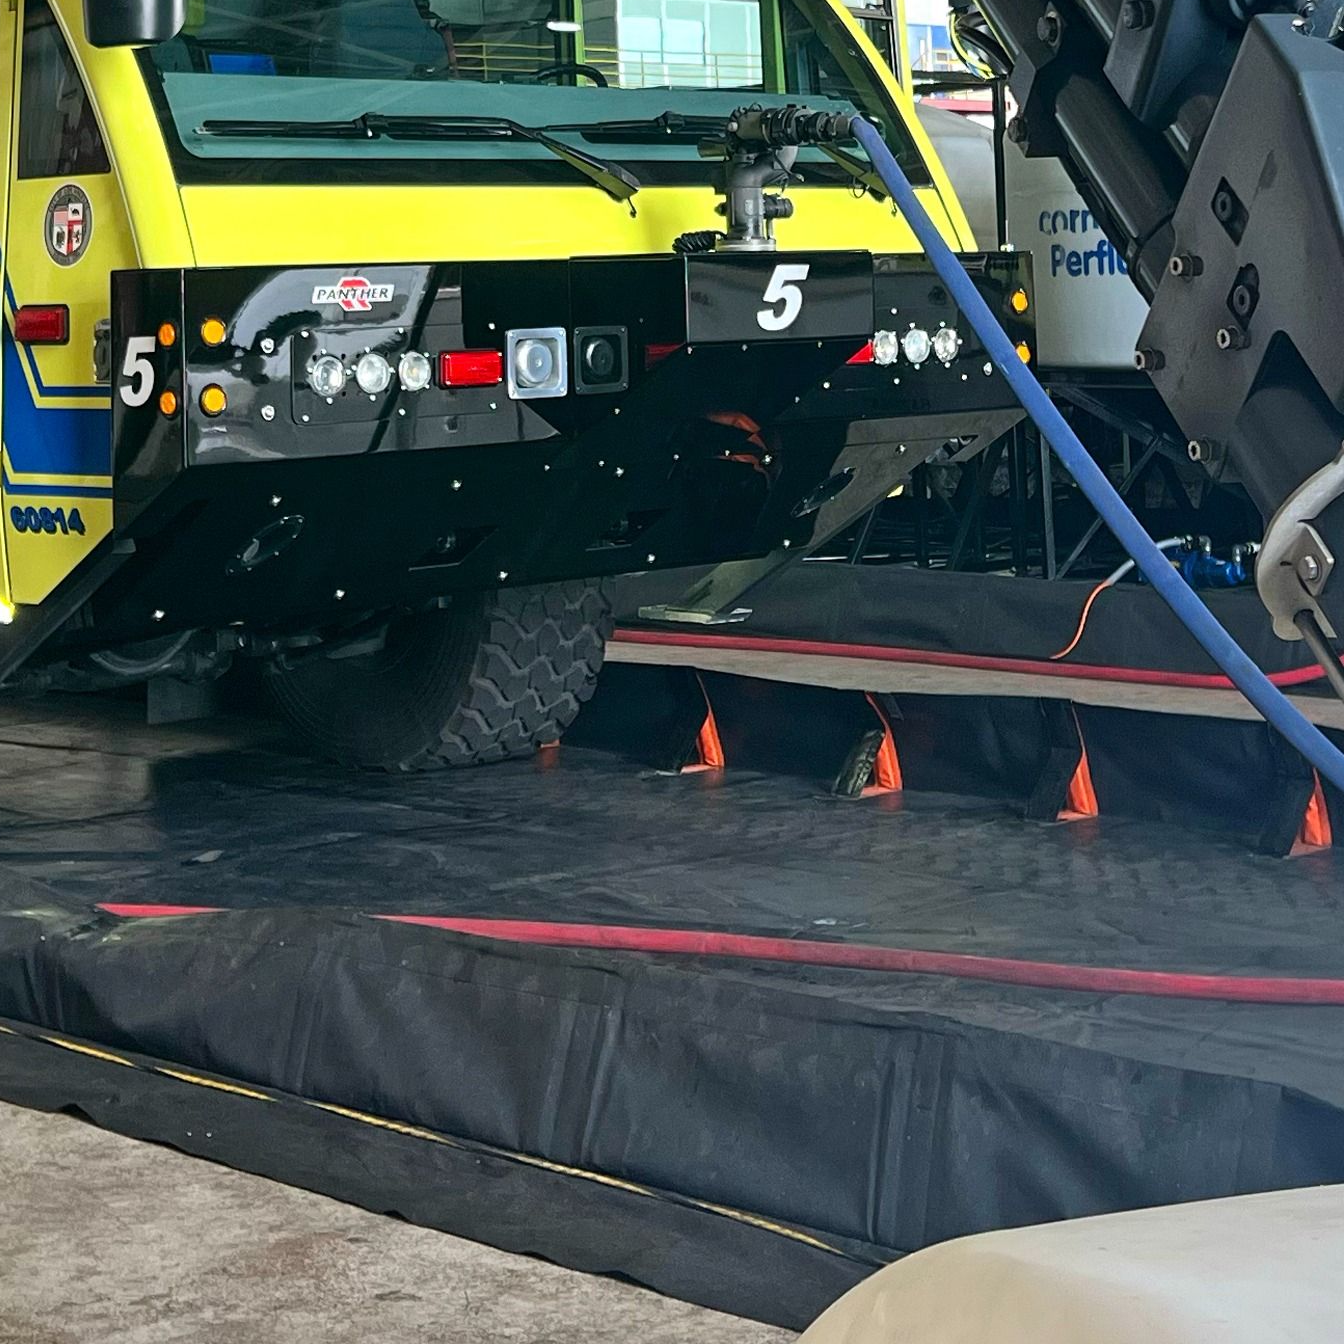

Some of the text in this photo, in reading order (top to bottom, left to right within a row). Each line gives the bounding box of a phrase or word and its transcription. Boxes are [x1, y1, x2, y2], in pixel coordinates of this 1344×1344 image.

[316, 287, 388, 301] PANTHER
[756, 263, 810, 331] 5
[119, 336, 156, 407] 5
[10, 505, 86, 536] 60814
